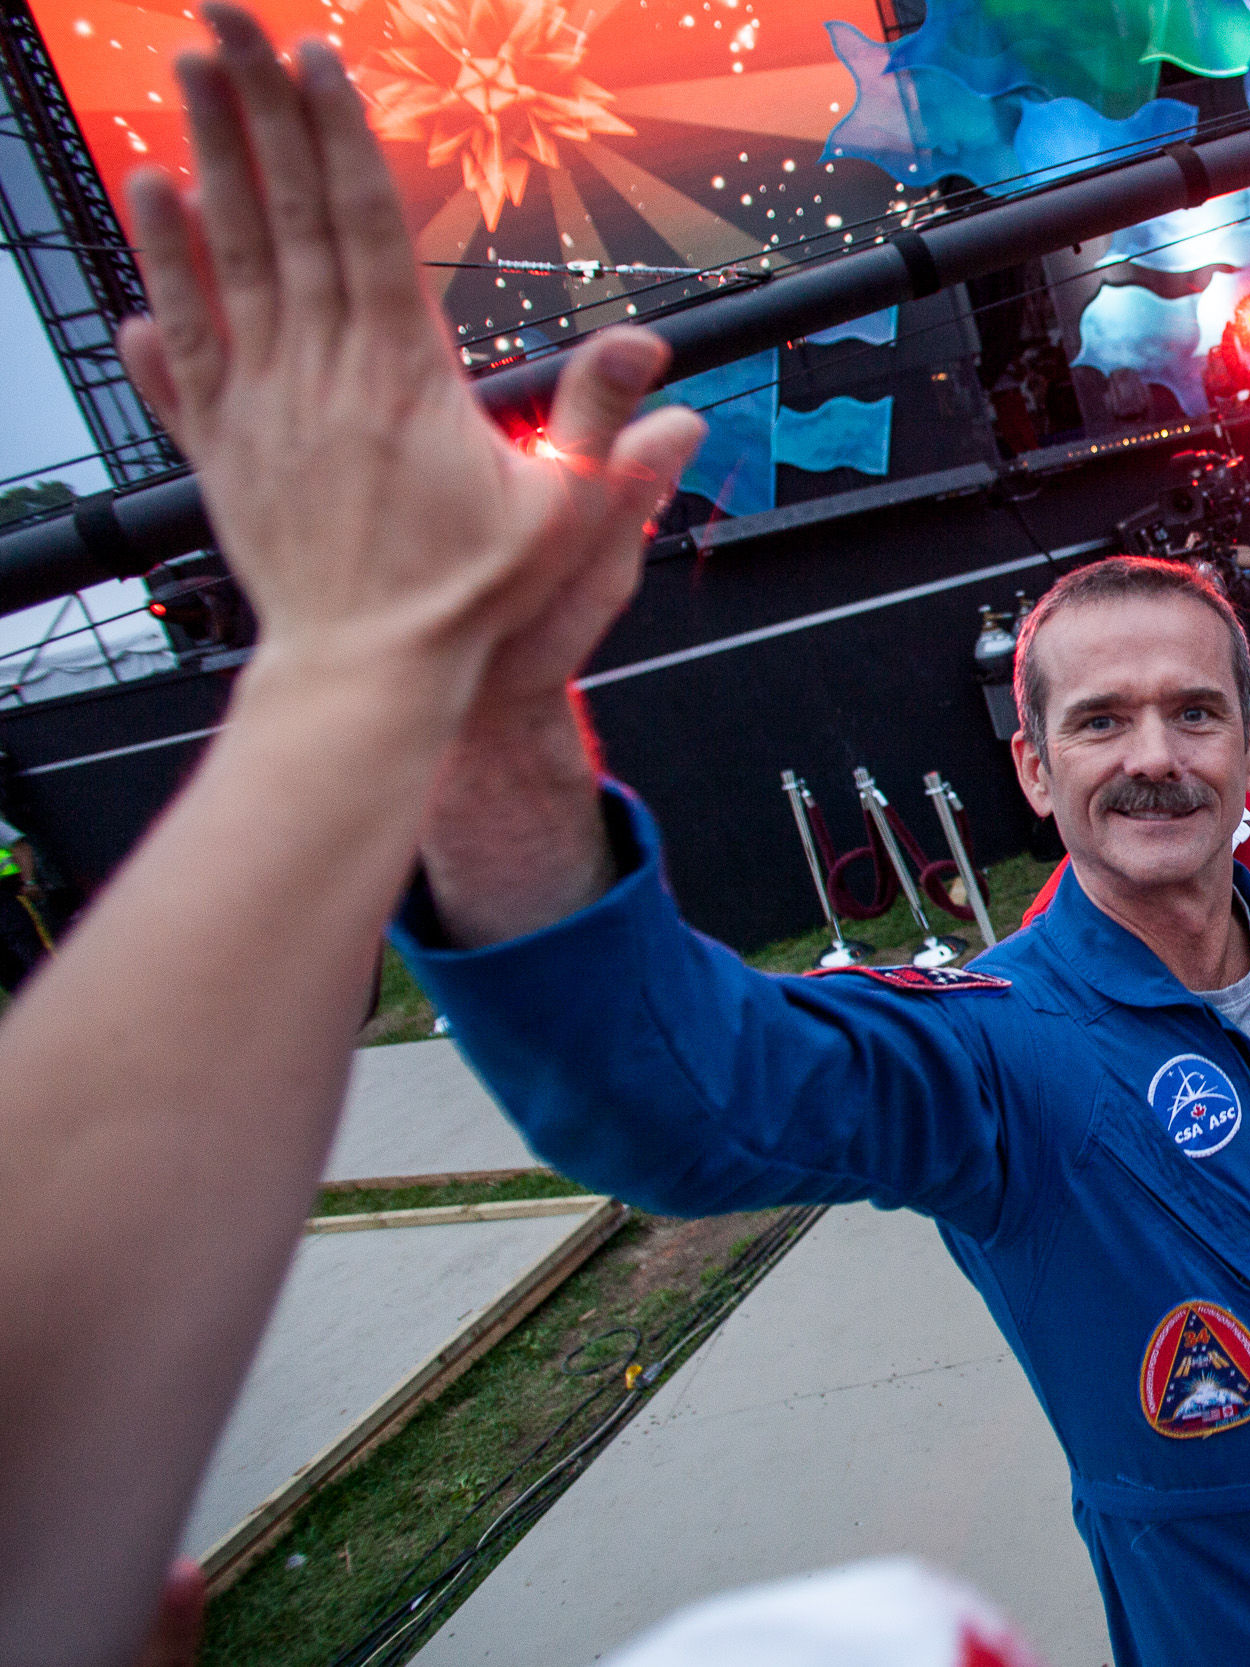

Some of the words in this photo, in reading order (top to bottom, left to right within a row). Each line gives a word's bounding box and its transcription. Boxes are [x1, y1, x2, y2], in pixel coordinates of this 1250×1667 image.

[1174, 1122, 1203, 1144] CSA
[1209, 1107, 1236, 1130] ASC
[1183, 1328, 1210, 1348] 34
